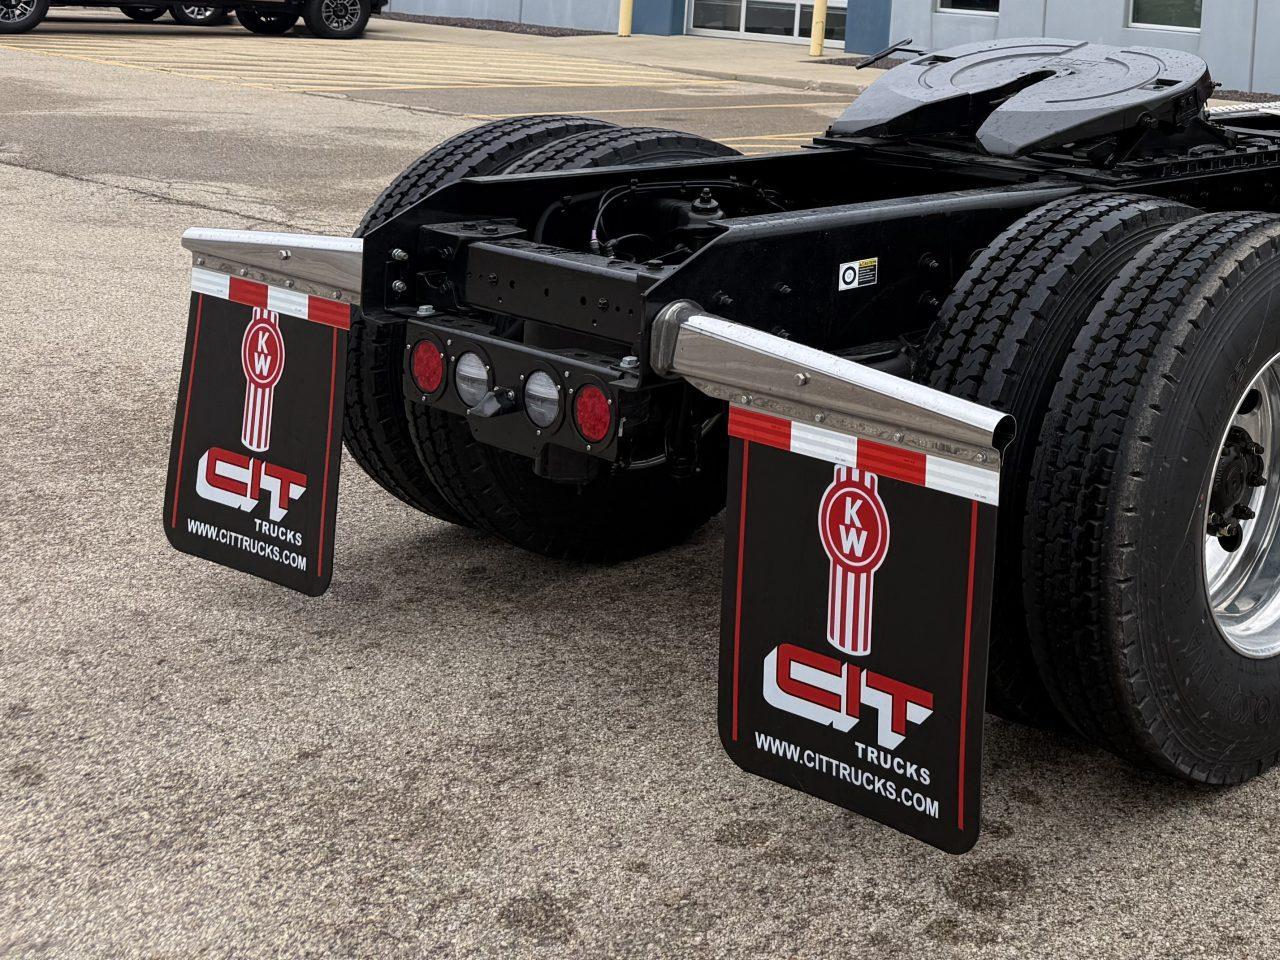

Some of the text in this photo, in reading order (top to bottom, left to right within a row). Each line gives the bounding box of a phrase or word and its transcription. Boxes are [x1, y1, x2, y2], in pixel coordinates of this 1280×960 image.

[258, 330, 269, 354] K
[254, 352, 272, 377] W
[196, 447, 308, 522] CIT
[844, 496, 863, 528] K
[187, 518, 307, 572] WWW.CITTRUCKS.COM
[254, 519, 303, 546] TRUCKS
[839, 524, 868, 558] W
[762, 643, 934, 750] CIT
[754, 731, 940, 820] WWW.CITTRUCKS.COM
[855, 741, 931, 786] TRUCKS
